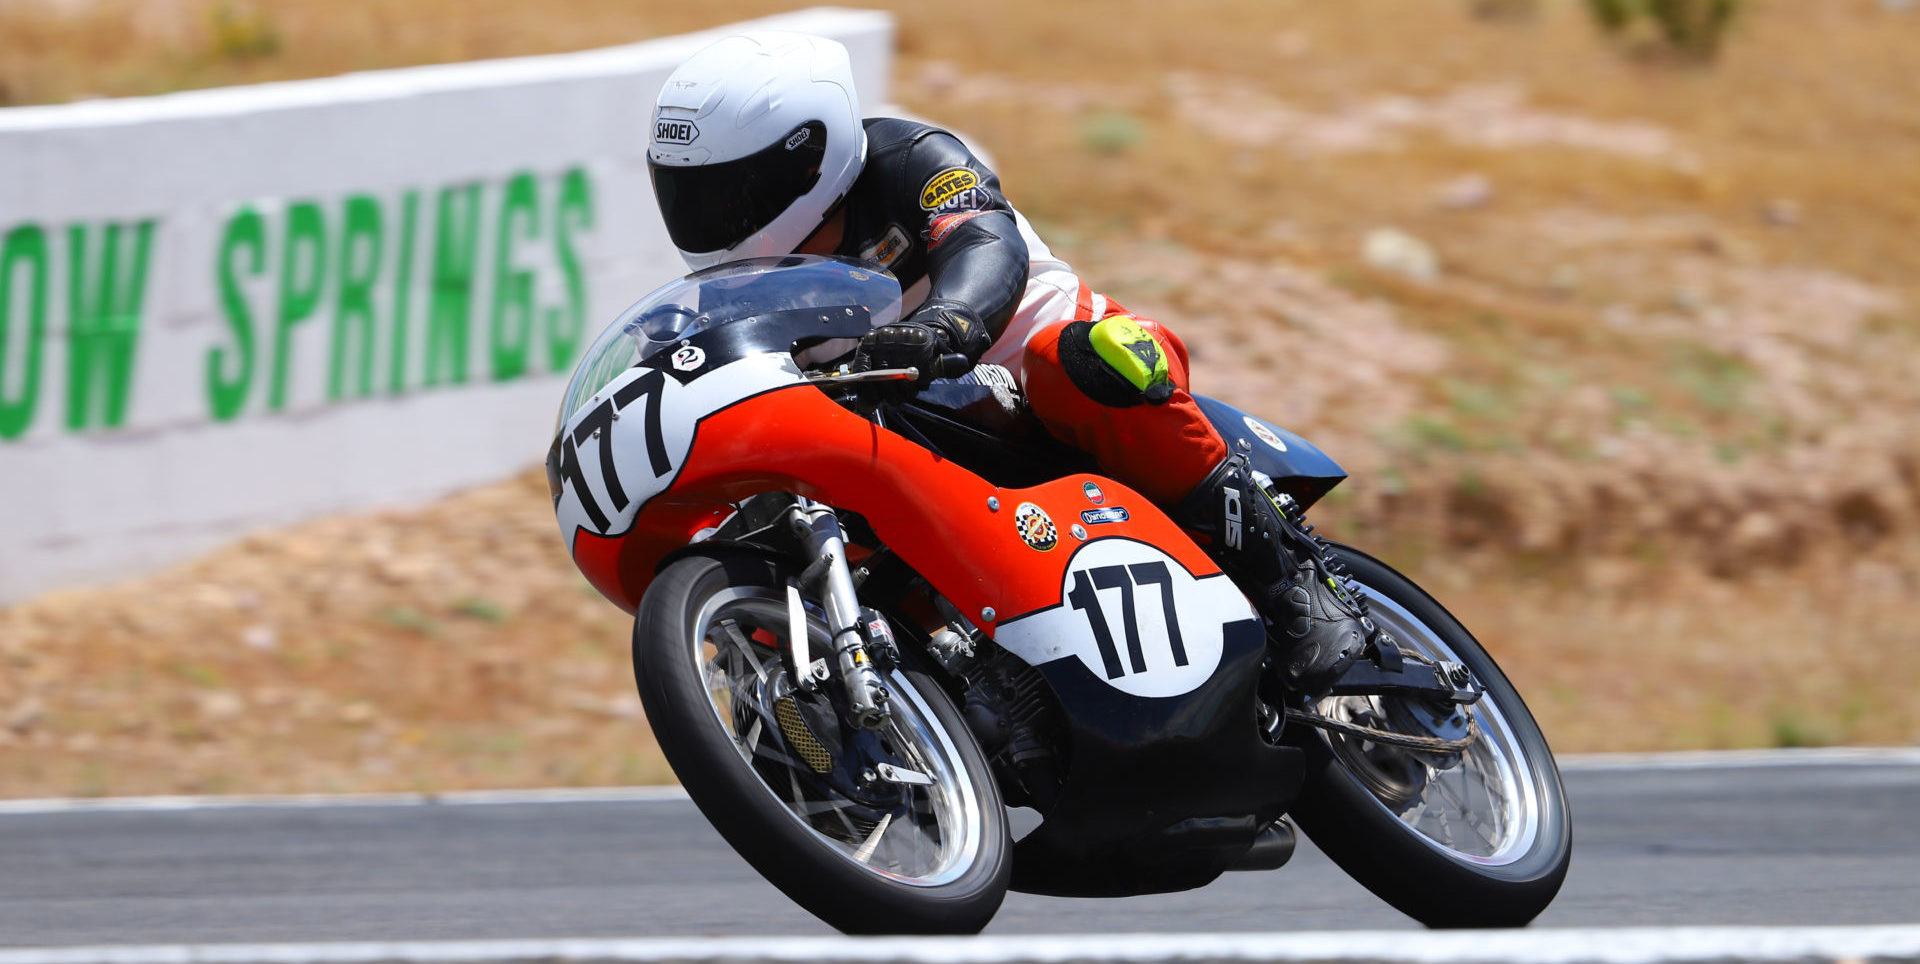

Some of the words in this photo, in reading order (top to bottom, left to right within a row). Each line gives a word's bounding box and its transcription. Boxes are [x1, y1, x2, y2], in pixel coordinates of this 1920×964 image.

[656, 123, 692, 140] SHOEI
[788, 130, 808, 148] SHOEI
[925, 173, 974, 205] BATES
[930, 172, 956, 188] CUSTOM
[0, 219, 156, 440] OW
[207, 166, 593, 421] SPRINGS
[561, 368, 673, 534] 177
[1067, 560, 1190, 681] 177
